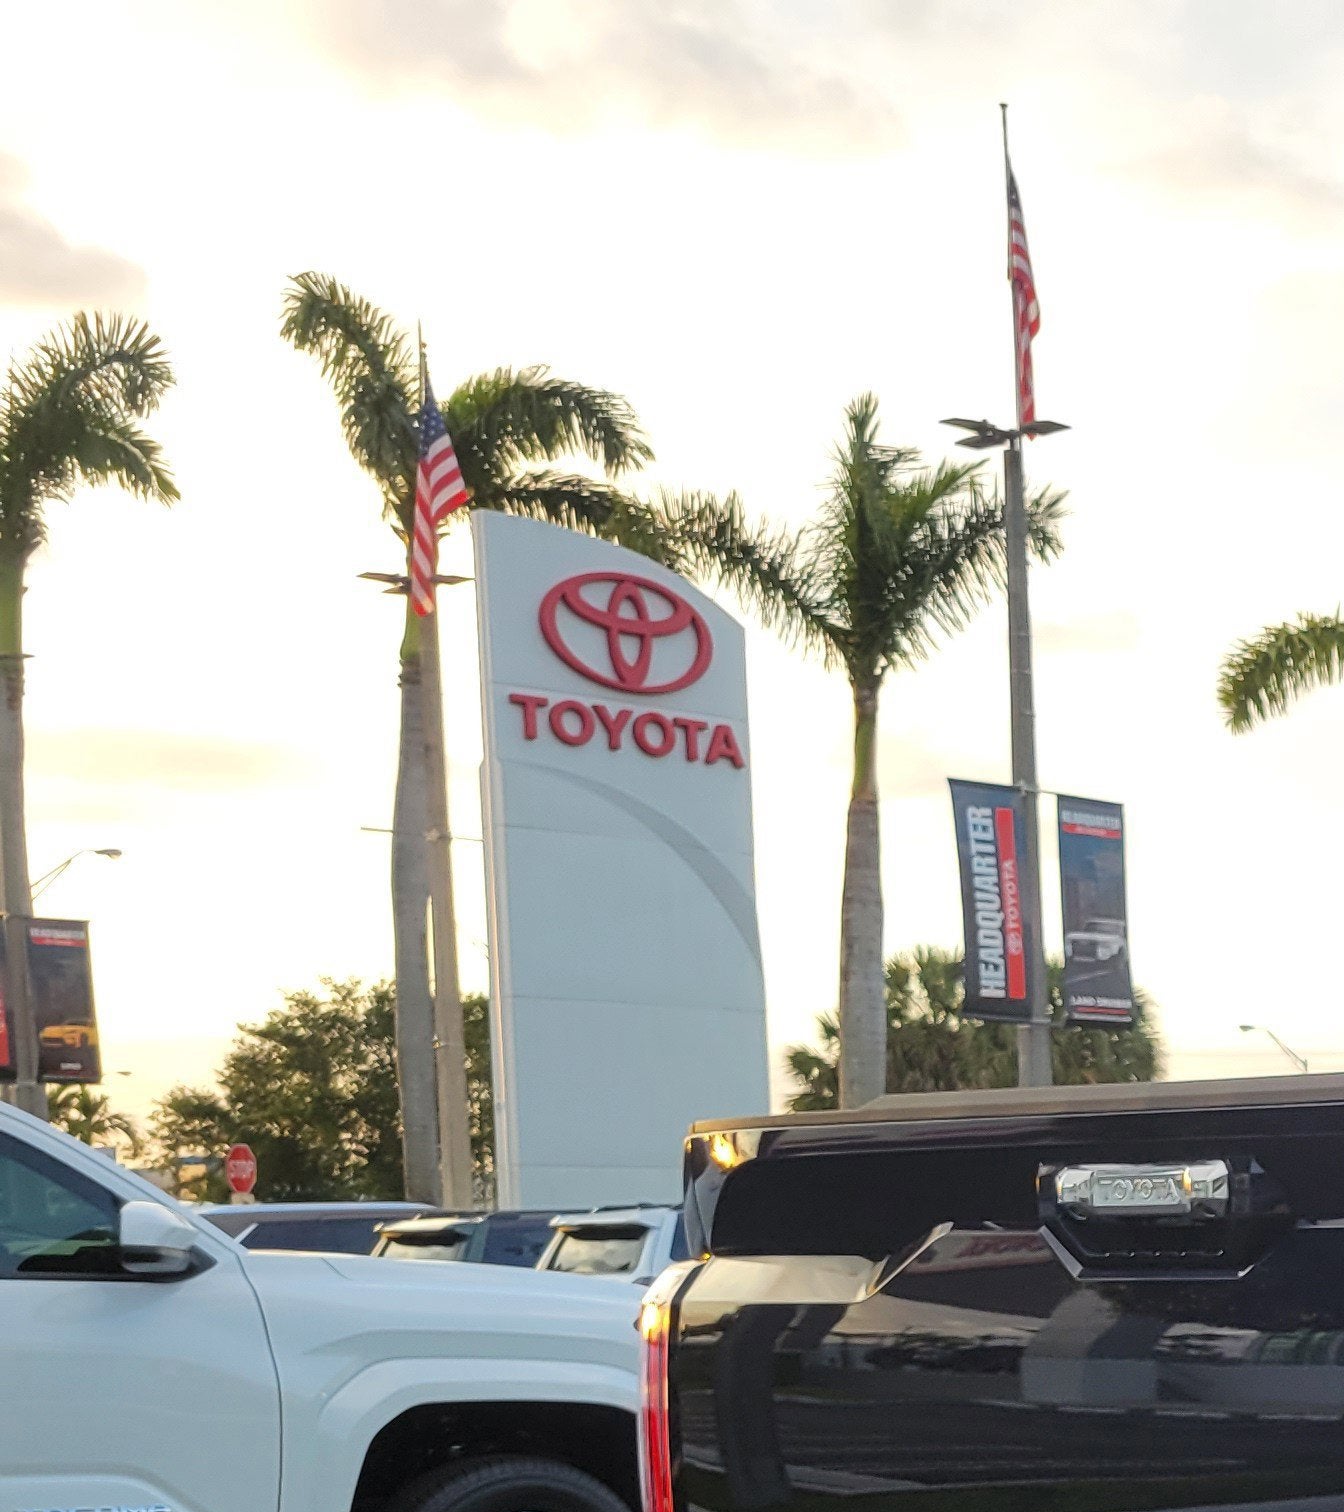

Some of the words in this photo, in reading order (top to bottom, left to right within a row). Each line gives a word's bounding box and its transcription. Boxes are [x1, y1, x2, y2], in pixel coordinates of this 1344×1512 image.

[508, 693, 745, 769] TOYOTA
[966, 806, 1006, 999] HEADQUARTER
[1003, 859, 1020, 928] TOYOTA
